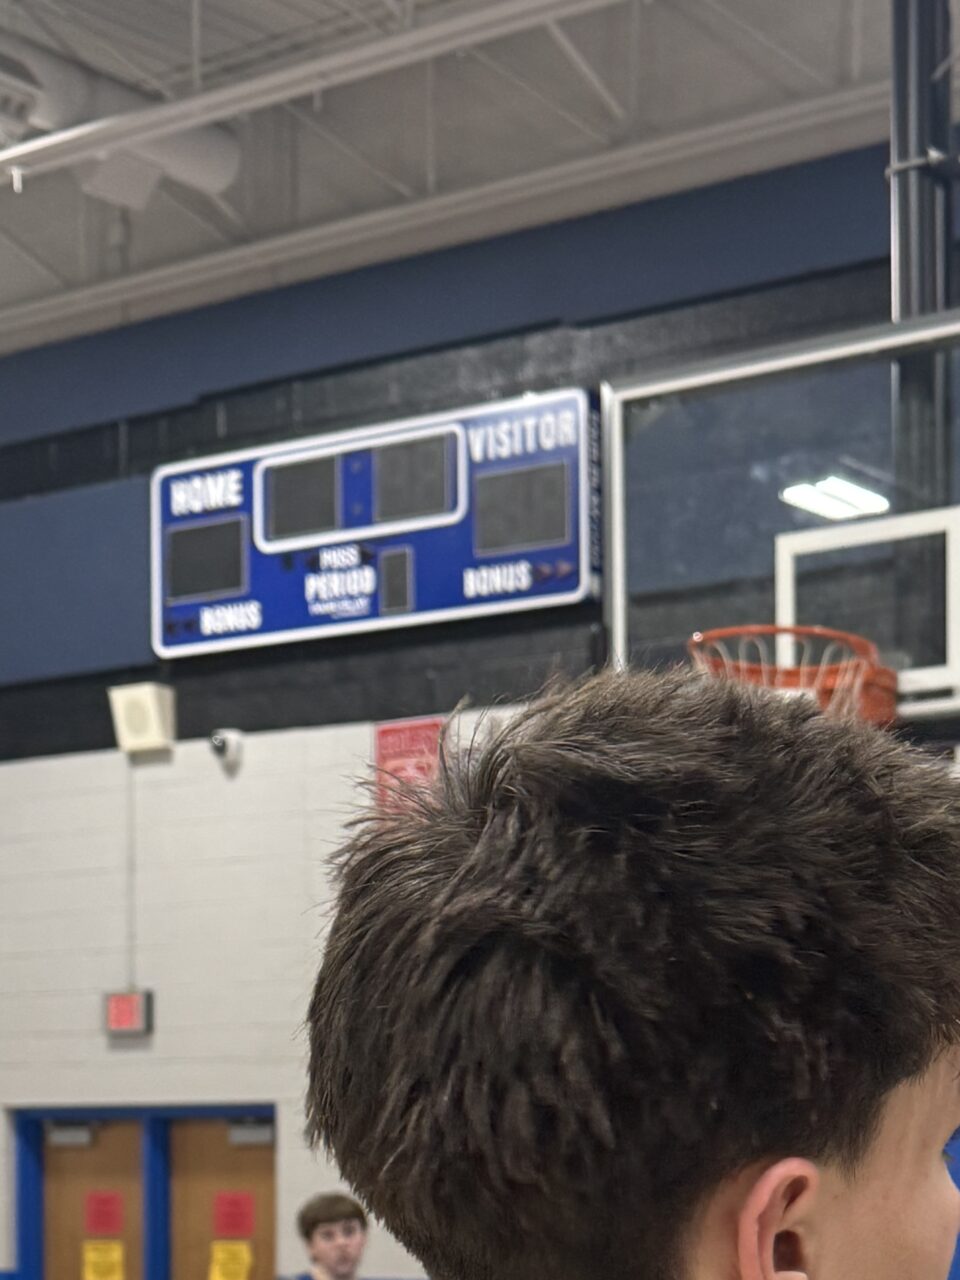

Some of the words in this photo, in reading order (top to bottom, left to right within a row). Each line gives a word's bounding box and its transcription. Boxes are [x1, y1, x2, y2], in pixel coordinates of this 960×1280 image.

[466, 408, 577, 463] VISITOR
[170, 467, 244, 517] HOME
[304, 565, 376, 603] PERIOD
[463, 560, 533, 599] BONUS
[200, 601, 263, 637] BONUS
